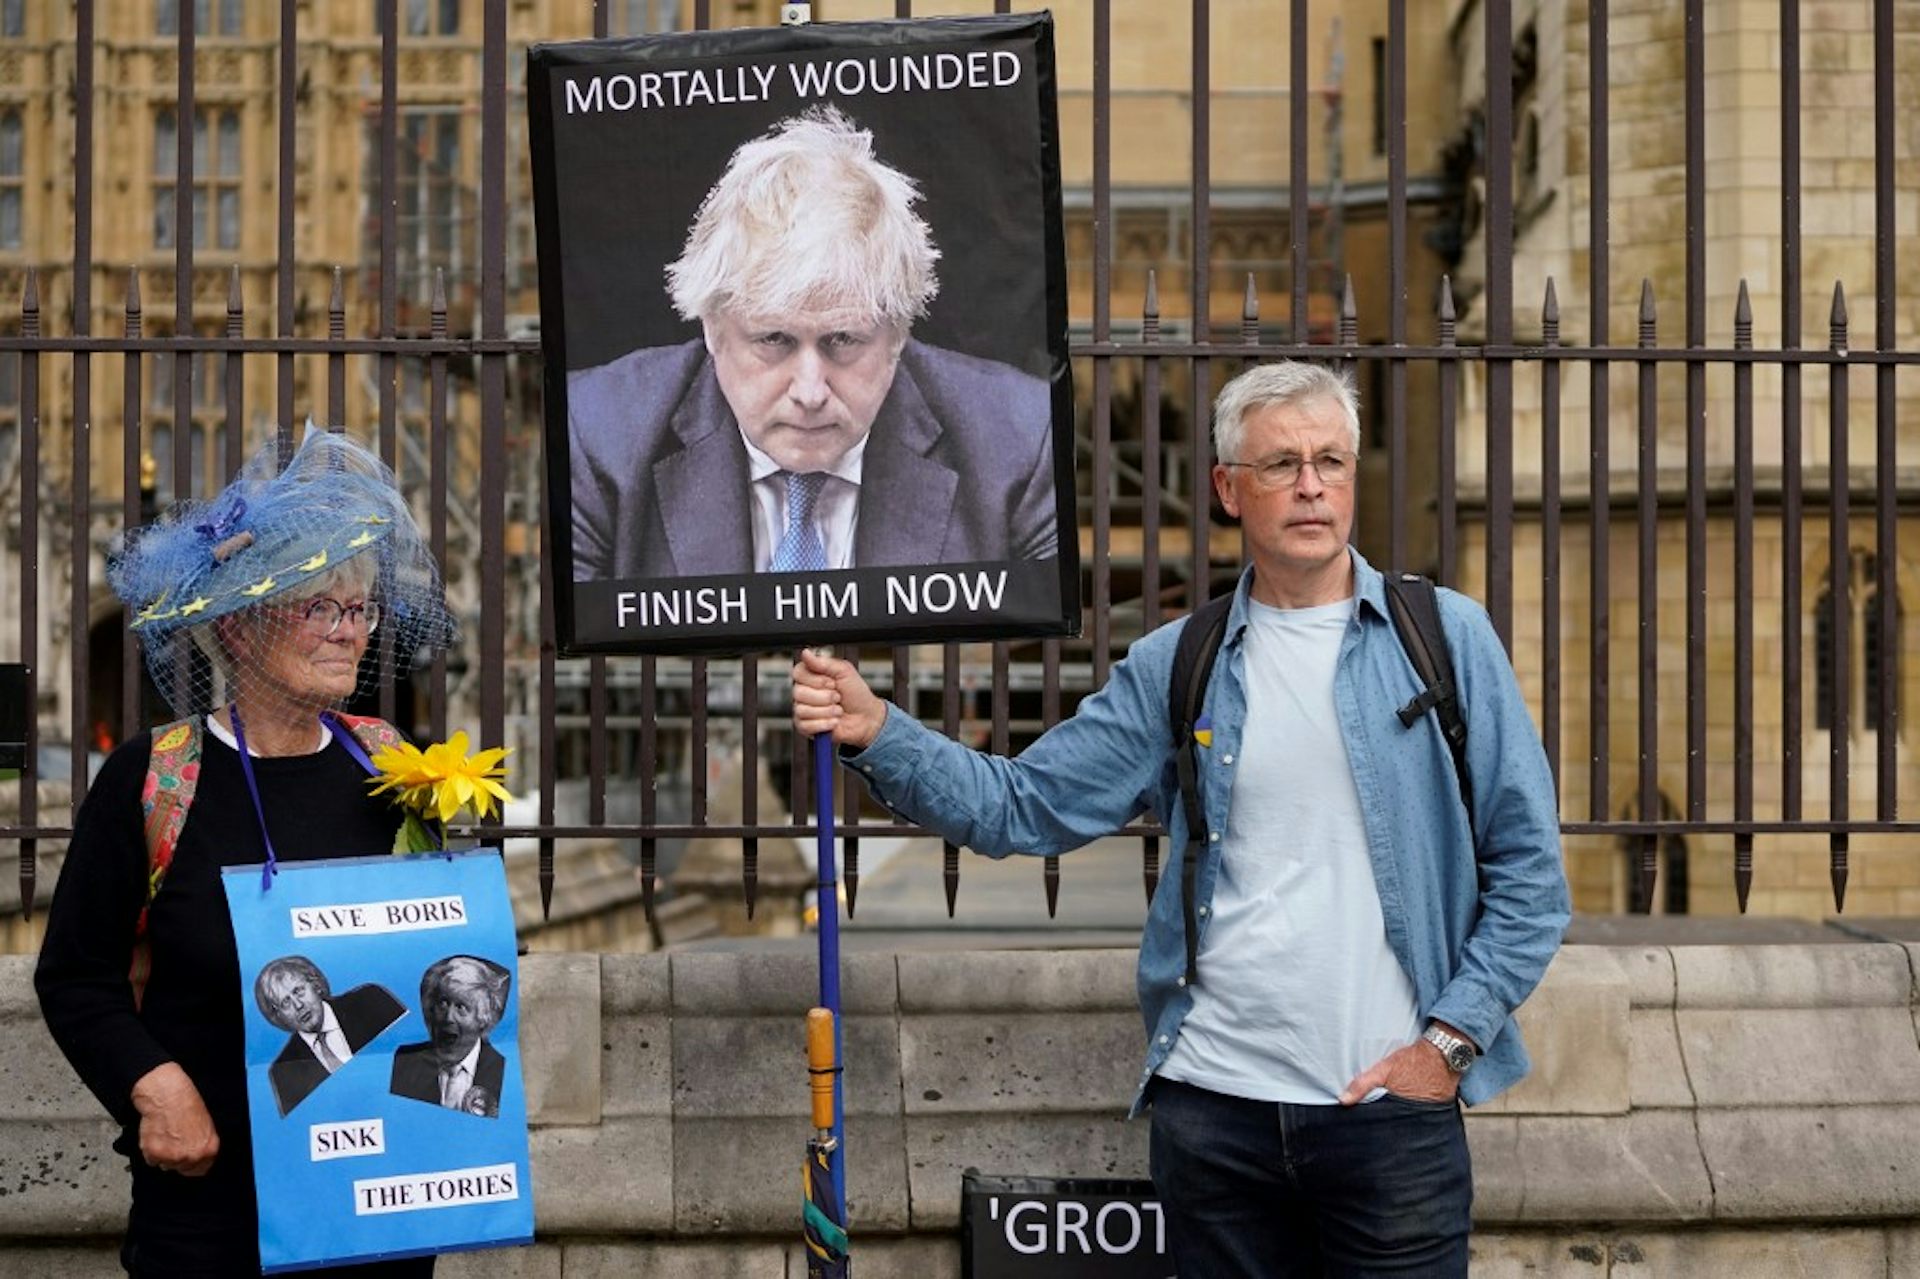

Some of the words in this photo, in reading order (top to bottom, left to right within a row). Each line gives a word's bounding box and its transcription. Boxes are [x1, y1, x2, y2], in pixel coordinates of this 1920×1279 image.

[565, 65, 777, 114] MORTALLY
[789, 51, 1021, 97] WOUNDED
[617, 586, 748, 628] FINISH
[775, 581, 859, 621] HIM
[886, 570, 1008, 614] NOW
[297, 908, 366, 931] SAVE
[386, 900, 463, 925] BORIS
[317, 1126, 378, 1152] SINK
[361, 1184, 414, 1208] THE
[420, 1173, 513, 1201] TORIES
